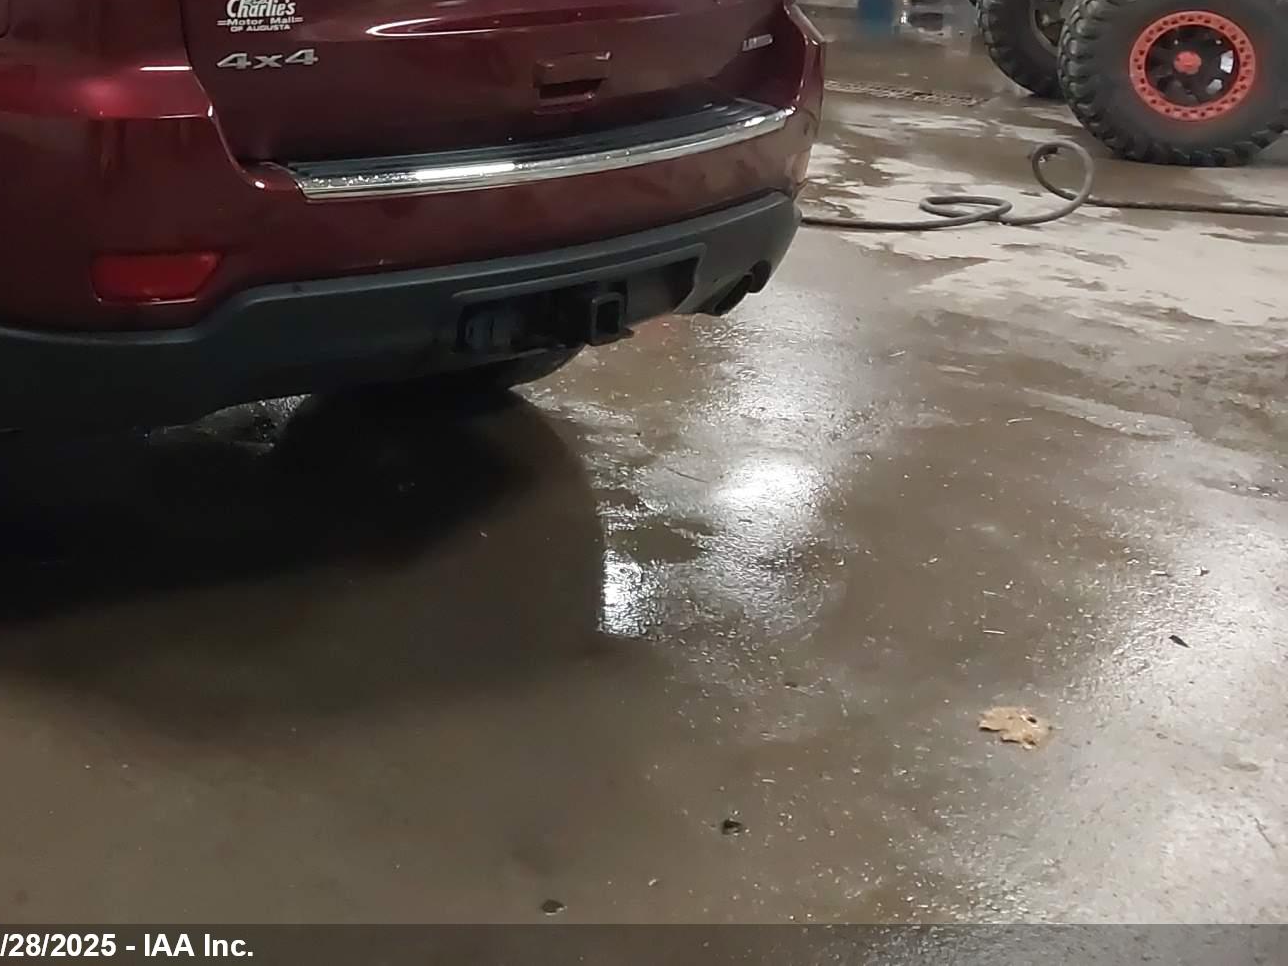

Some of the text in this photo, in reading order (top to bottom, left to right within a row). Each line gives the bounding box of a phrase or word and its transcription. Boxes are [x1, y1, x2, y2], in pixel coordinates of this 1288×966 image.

[227, 18, 264, 26] Motor
[246, 24, 291, 32] AUGUSTA
[216, 49, 319, 69] 4x4
